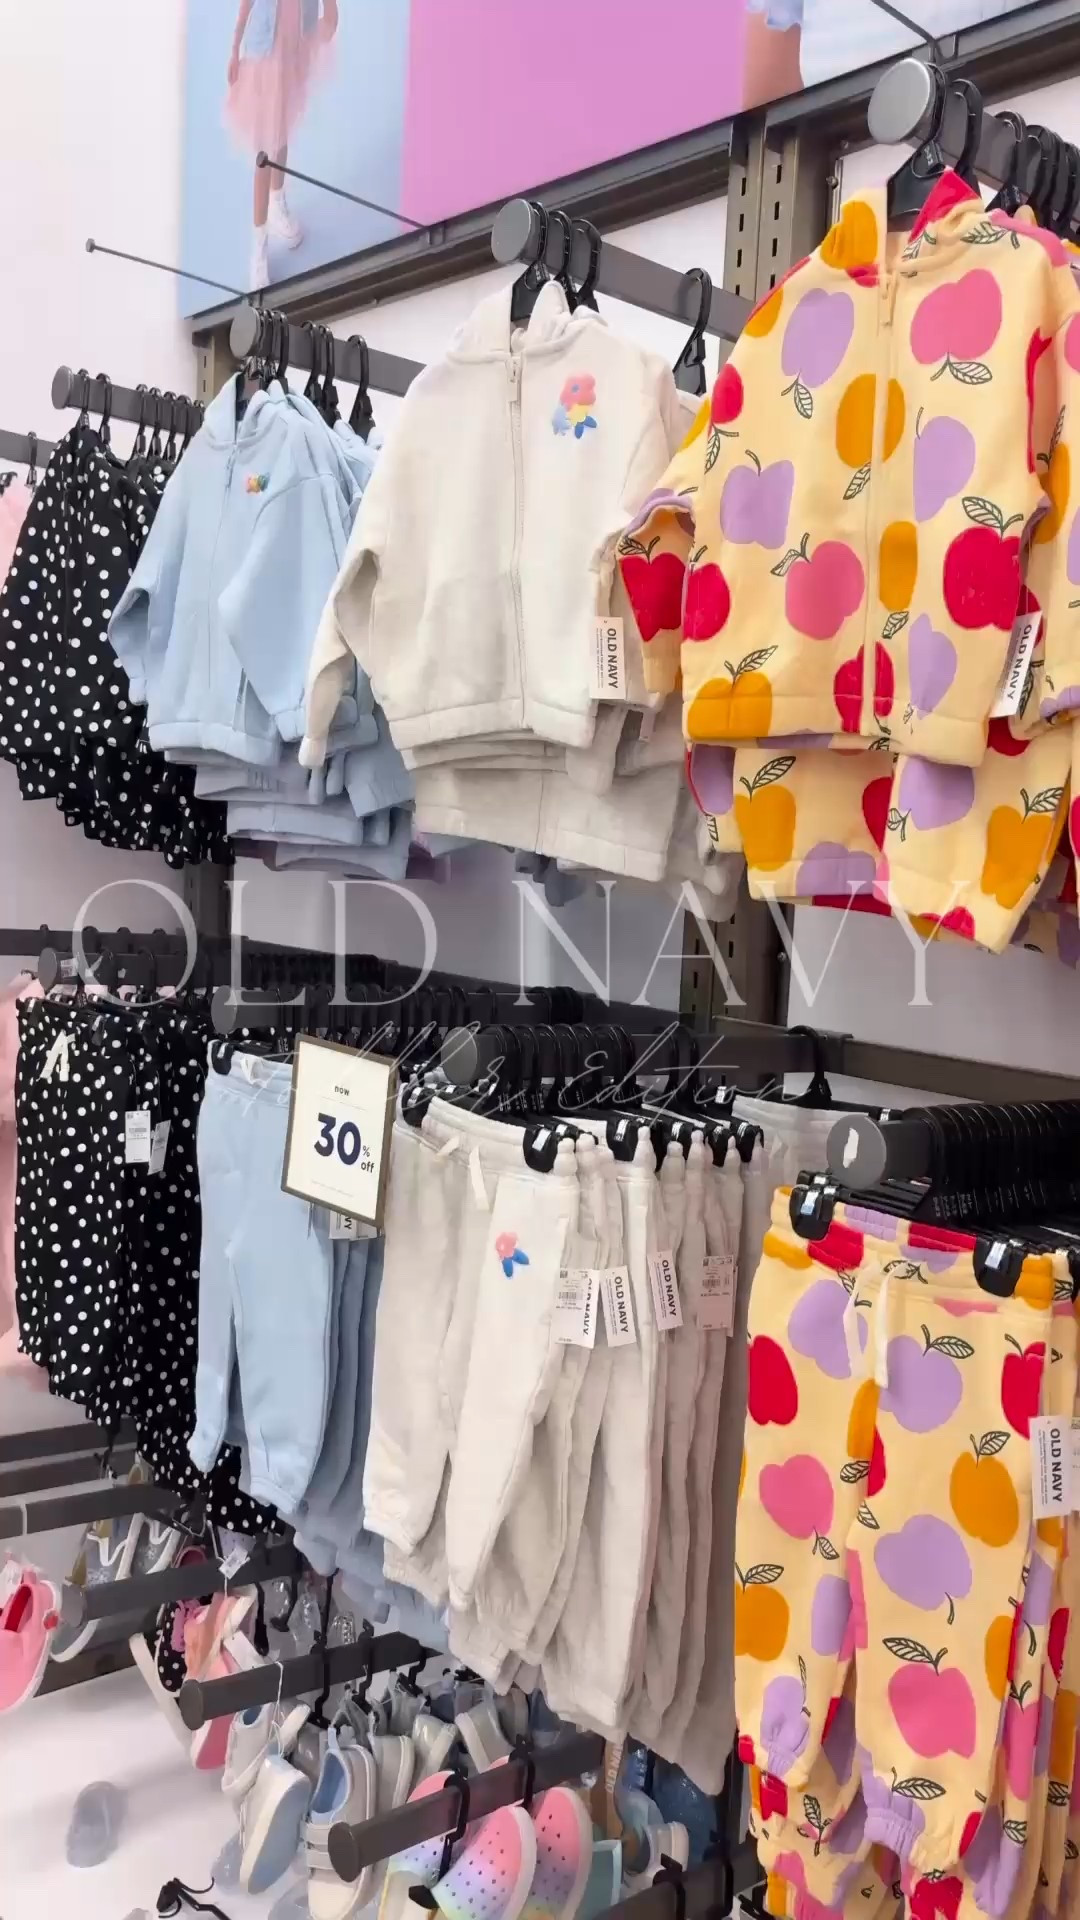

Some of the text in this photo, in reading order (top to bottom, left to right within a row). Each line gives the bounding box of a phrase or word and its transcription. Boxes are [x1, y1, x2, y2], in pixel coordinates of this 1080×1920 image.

[607, 628, 618, 689] OLD NAVY
[1018, 624, 1032, 654] OLD
[1007, 658, 1024, 700] NAVY
[334, 1084, 350, 1097] now
[360, 1160, 375, 1174] off
[614, 1276, 629, 1333] OLD NAVY
[661, 1259, 677, 1317] OLD NAVY
[1050, 1428, 1063, 1502] OLD NAVY
